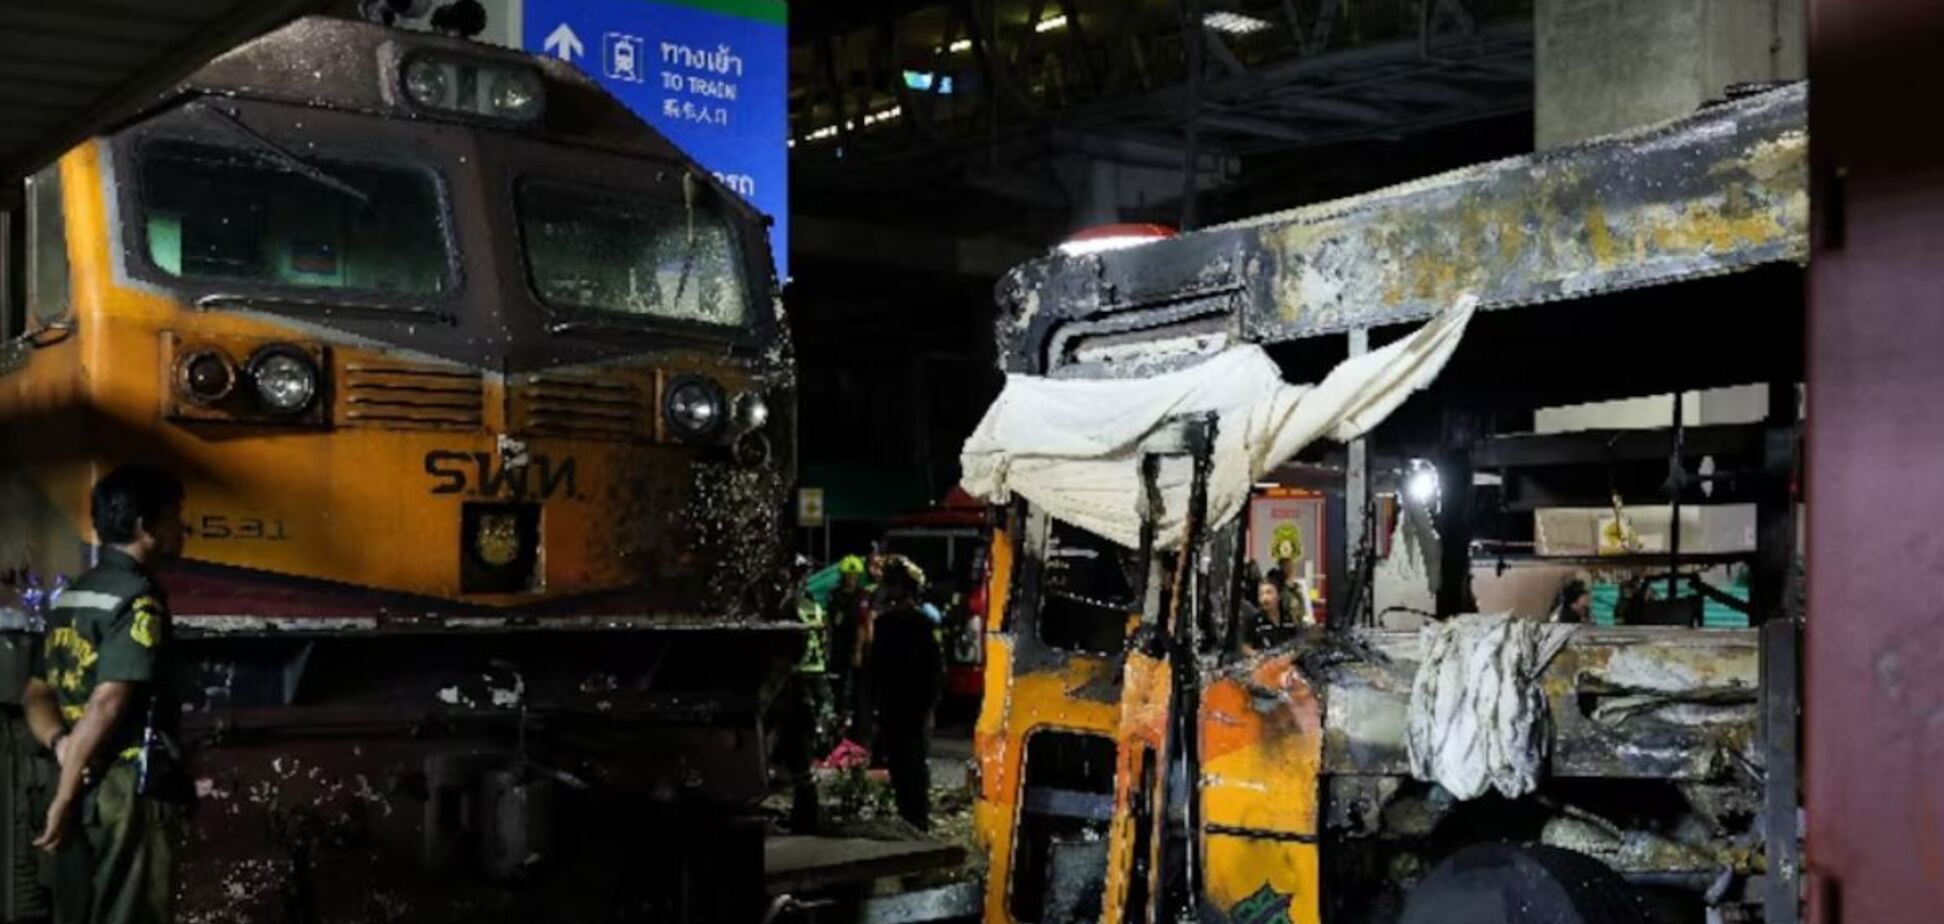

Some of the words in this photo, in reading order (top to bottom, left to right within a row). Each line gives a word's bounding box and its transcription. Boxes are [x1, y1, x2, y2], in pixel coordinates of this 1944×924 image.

[660, 71, 684, 92] TO
[688, 76, 737, 100] TRAIN
[183, 515, 287, 542] 531
